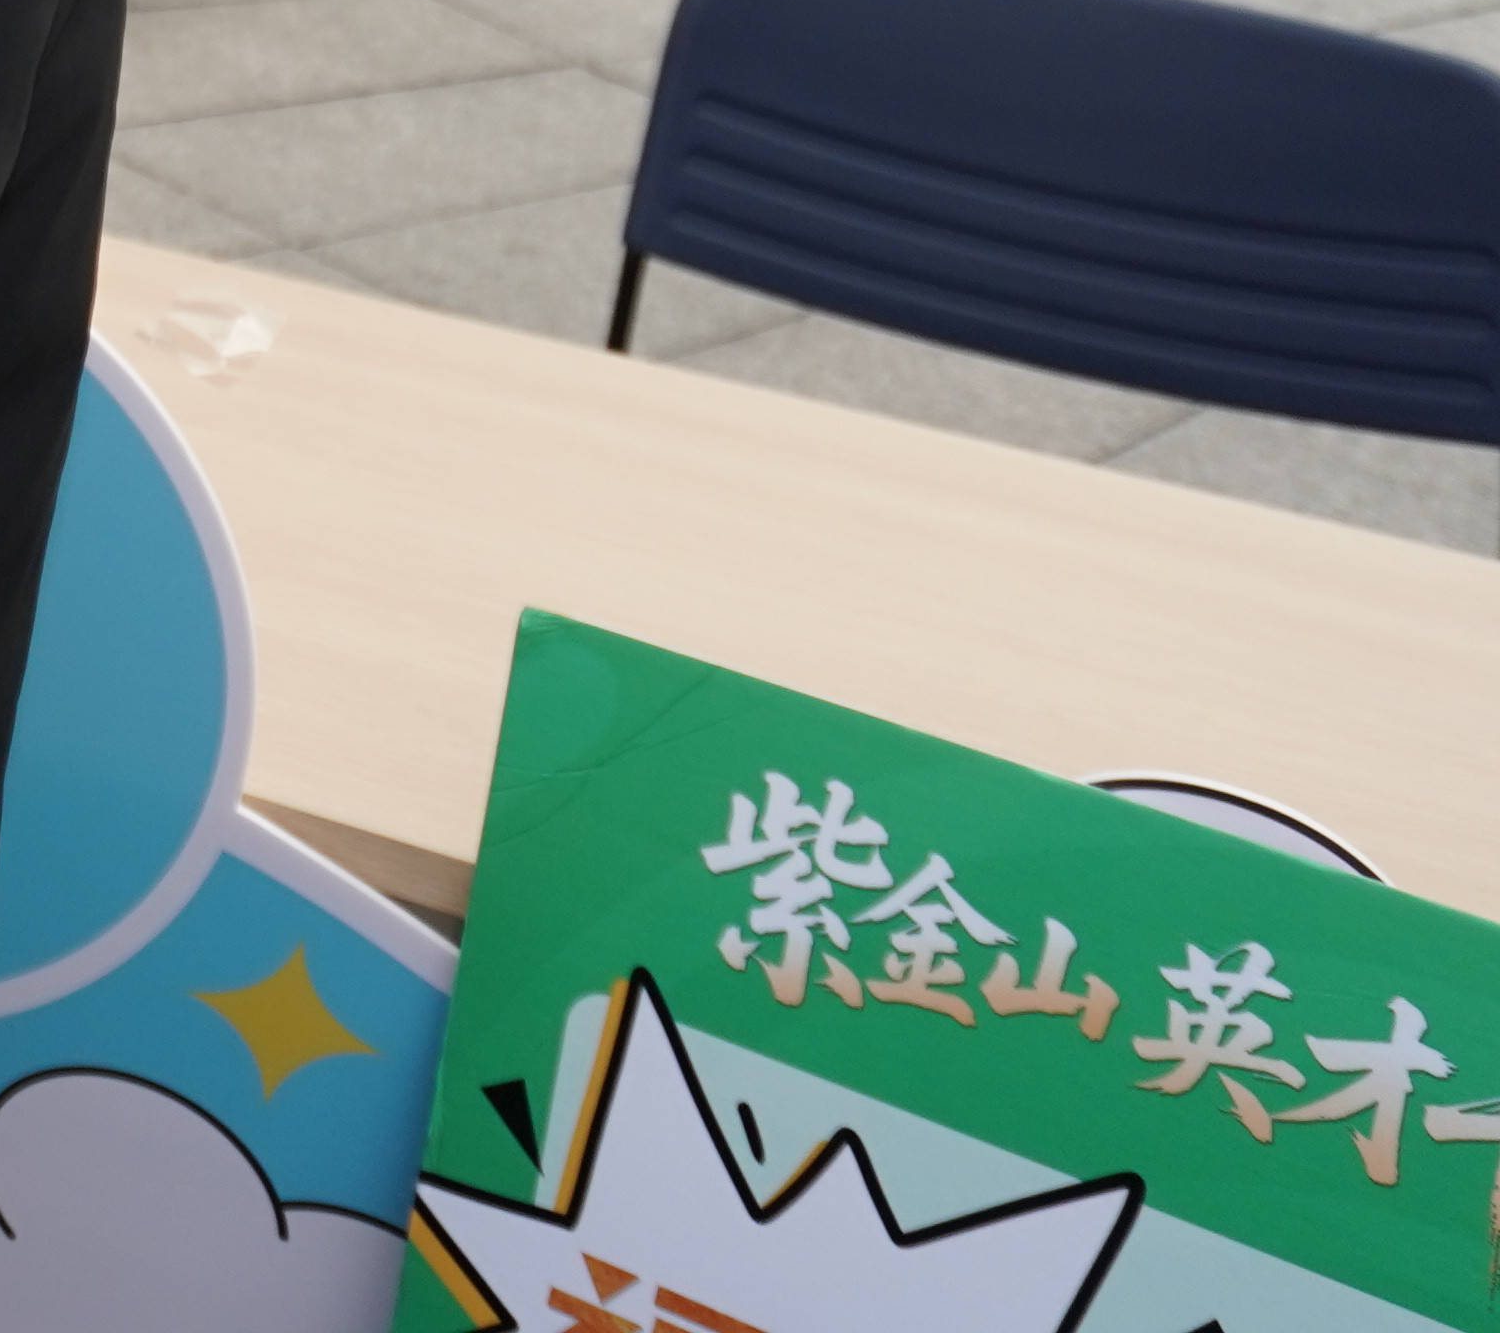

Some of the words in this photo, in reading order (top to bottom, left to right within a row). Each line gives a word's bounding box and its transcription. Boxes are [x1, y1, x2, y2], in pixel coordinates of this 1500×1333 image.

[701, 769, 1500, 1198] 紫金山英才
